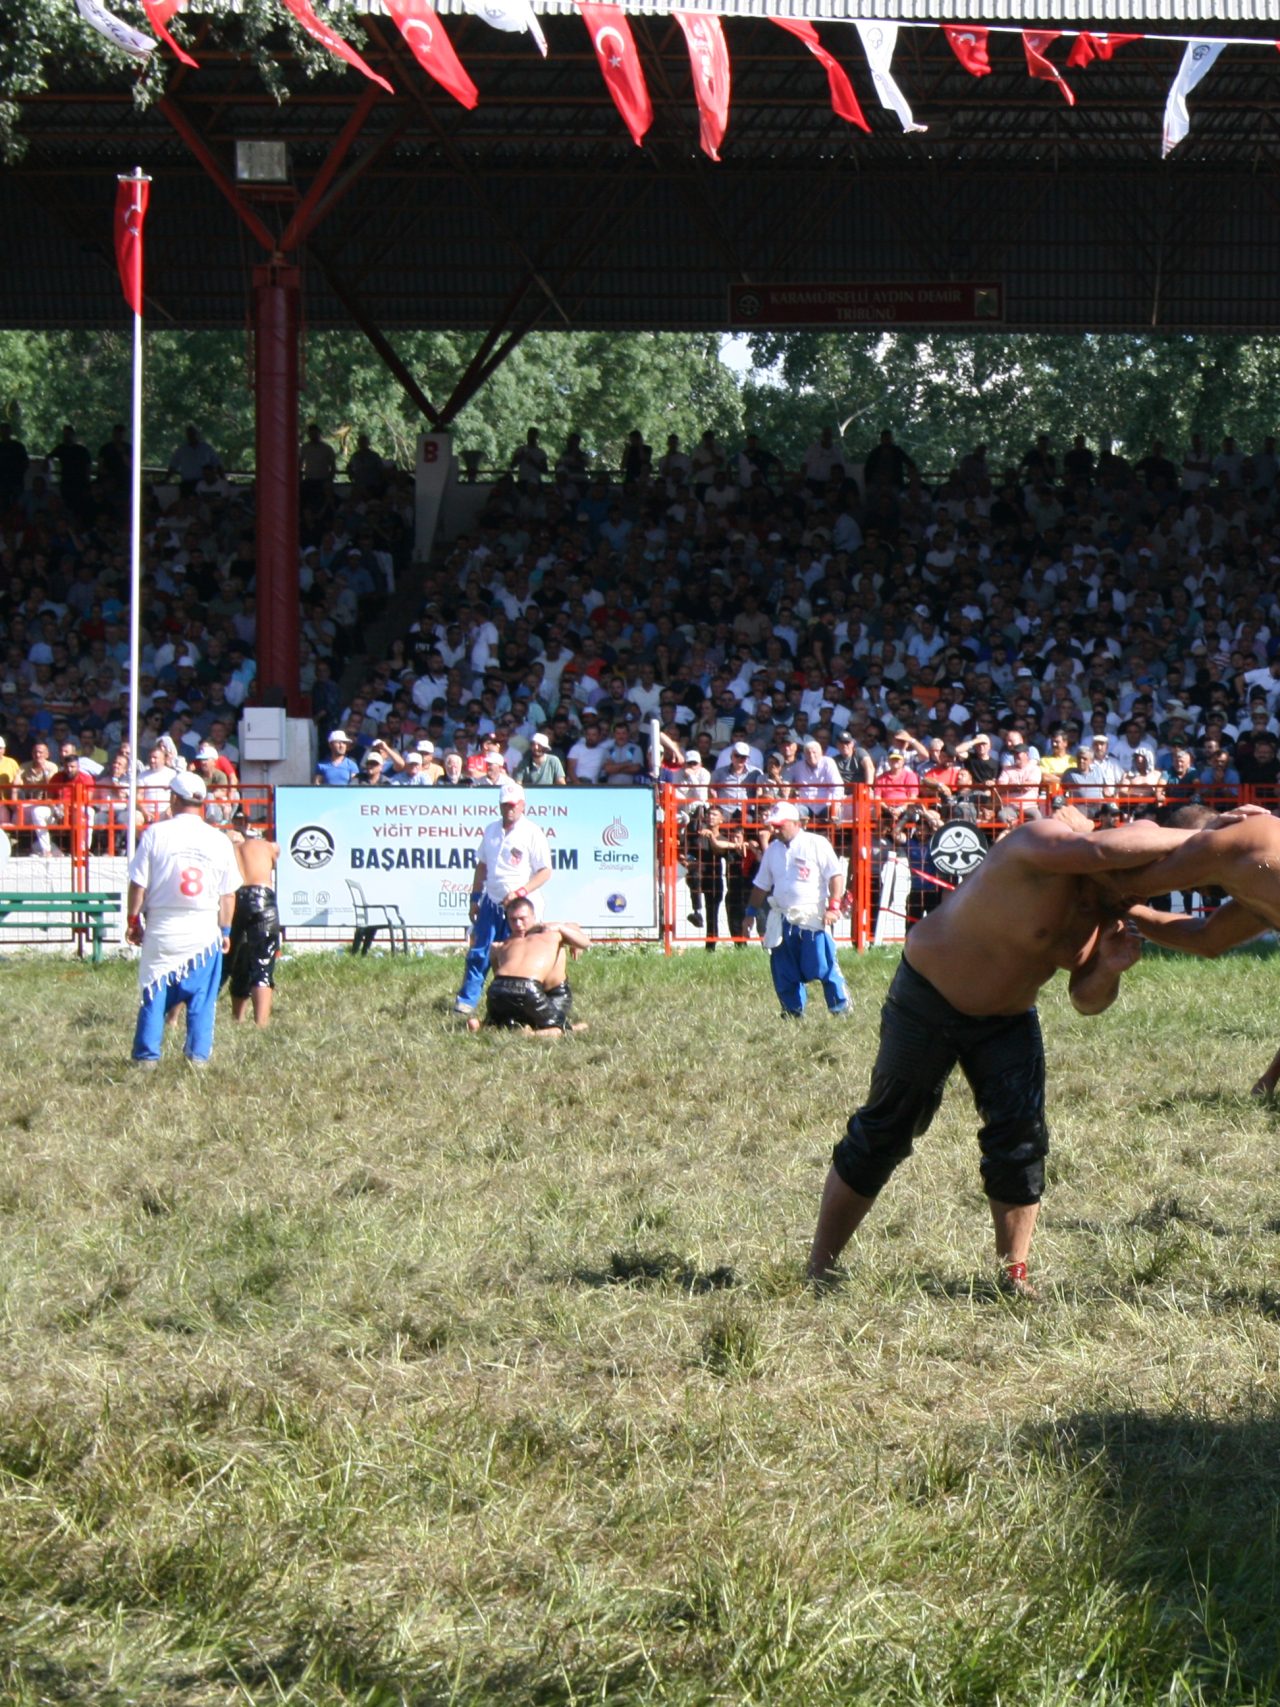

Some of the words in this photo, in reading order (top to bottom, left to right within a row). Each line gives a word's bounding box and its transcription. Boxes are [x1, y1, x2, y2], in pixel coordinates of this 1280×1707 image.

[873, 291, 914, 304] AYDIN
[918, 290, 961, 304] DEMİR
[424, 441, 438, 462] B
[360, 805, 380, 816] ER
[385, 805, 457, 816] MEYDANI
[463, 805, 568, 817] KIRKAR'IN
[372, 823, 413, 837] YİĞİT
[351, 848, 477, 871] BAŞARILAR
[594, 850, 639, 862] Edirne
[179, 867, 204, 897] 8
